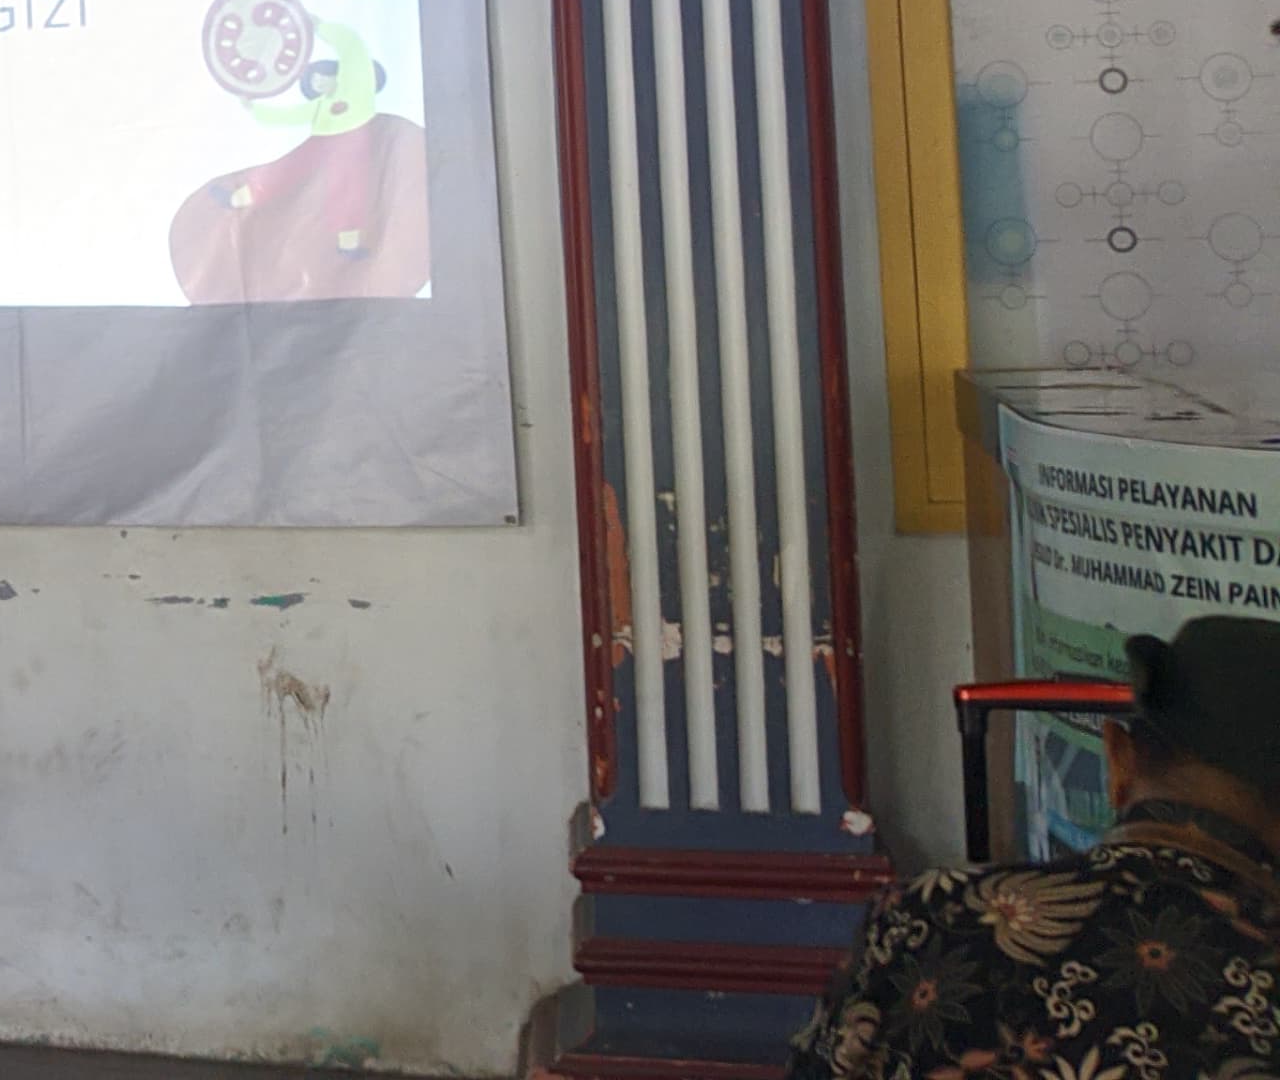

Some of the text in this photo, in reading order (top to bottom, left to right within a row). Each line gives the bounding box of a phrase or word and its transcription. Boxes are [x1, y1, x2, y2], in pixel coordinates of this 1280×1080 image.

[1038, 461, 1258, 519] INFORMASI PELAYANAN
[1046, 504, 1118, 544] SPESIALIS
[1122, 520, 1243, 565] PENYAKIT
[1253, 535, 1280, 568] D
[1071, 553, 1166, 595] MUHAMMAD
[1171, 573, 1221, 604] ZEIN
